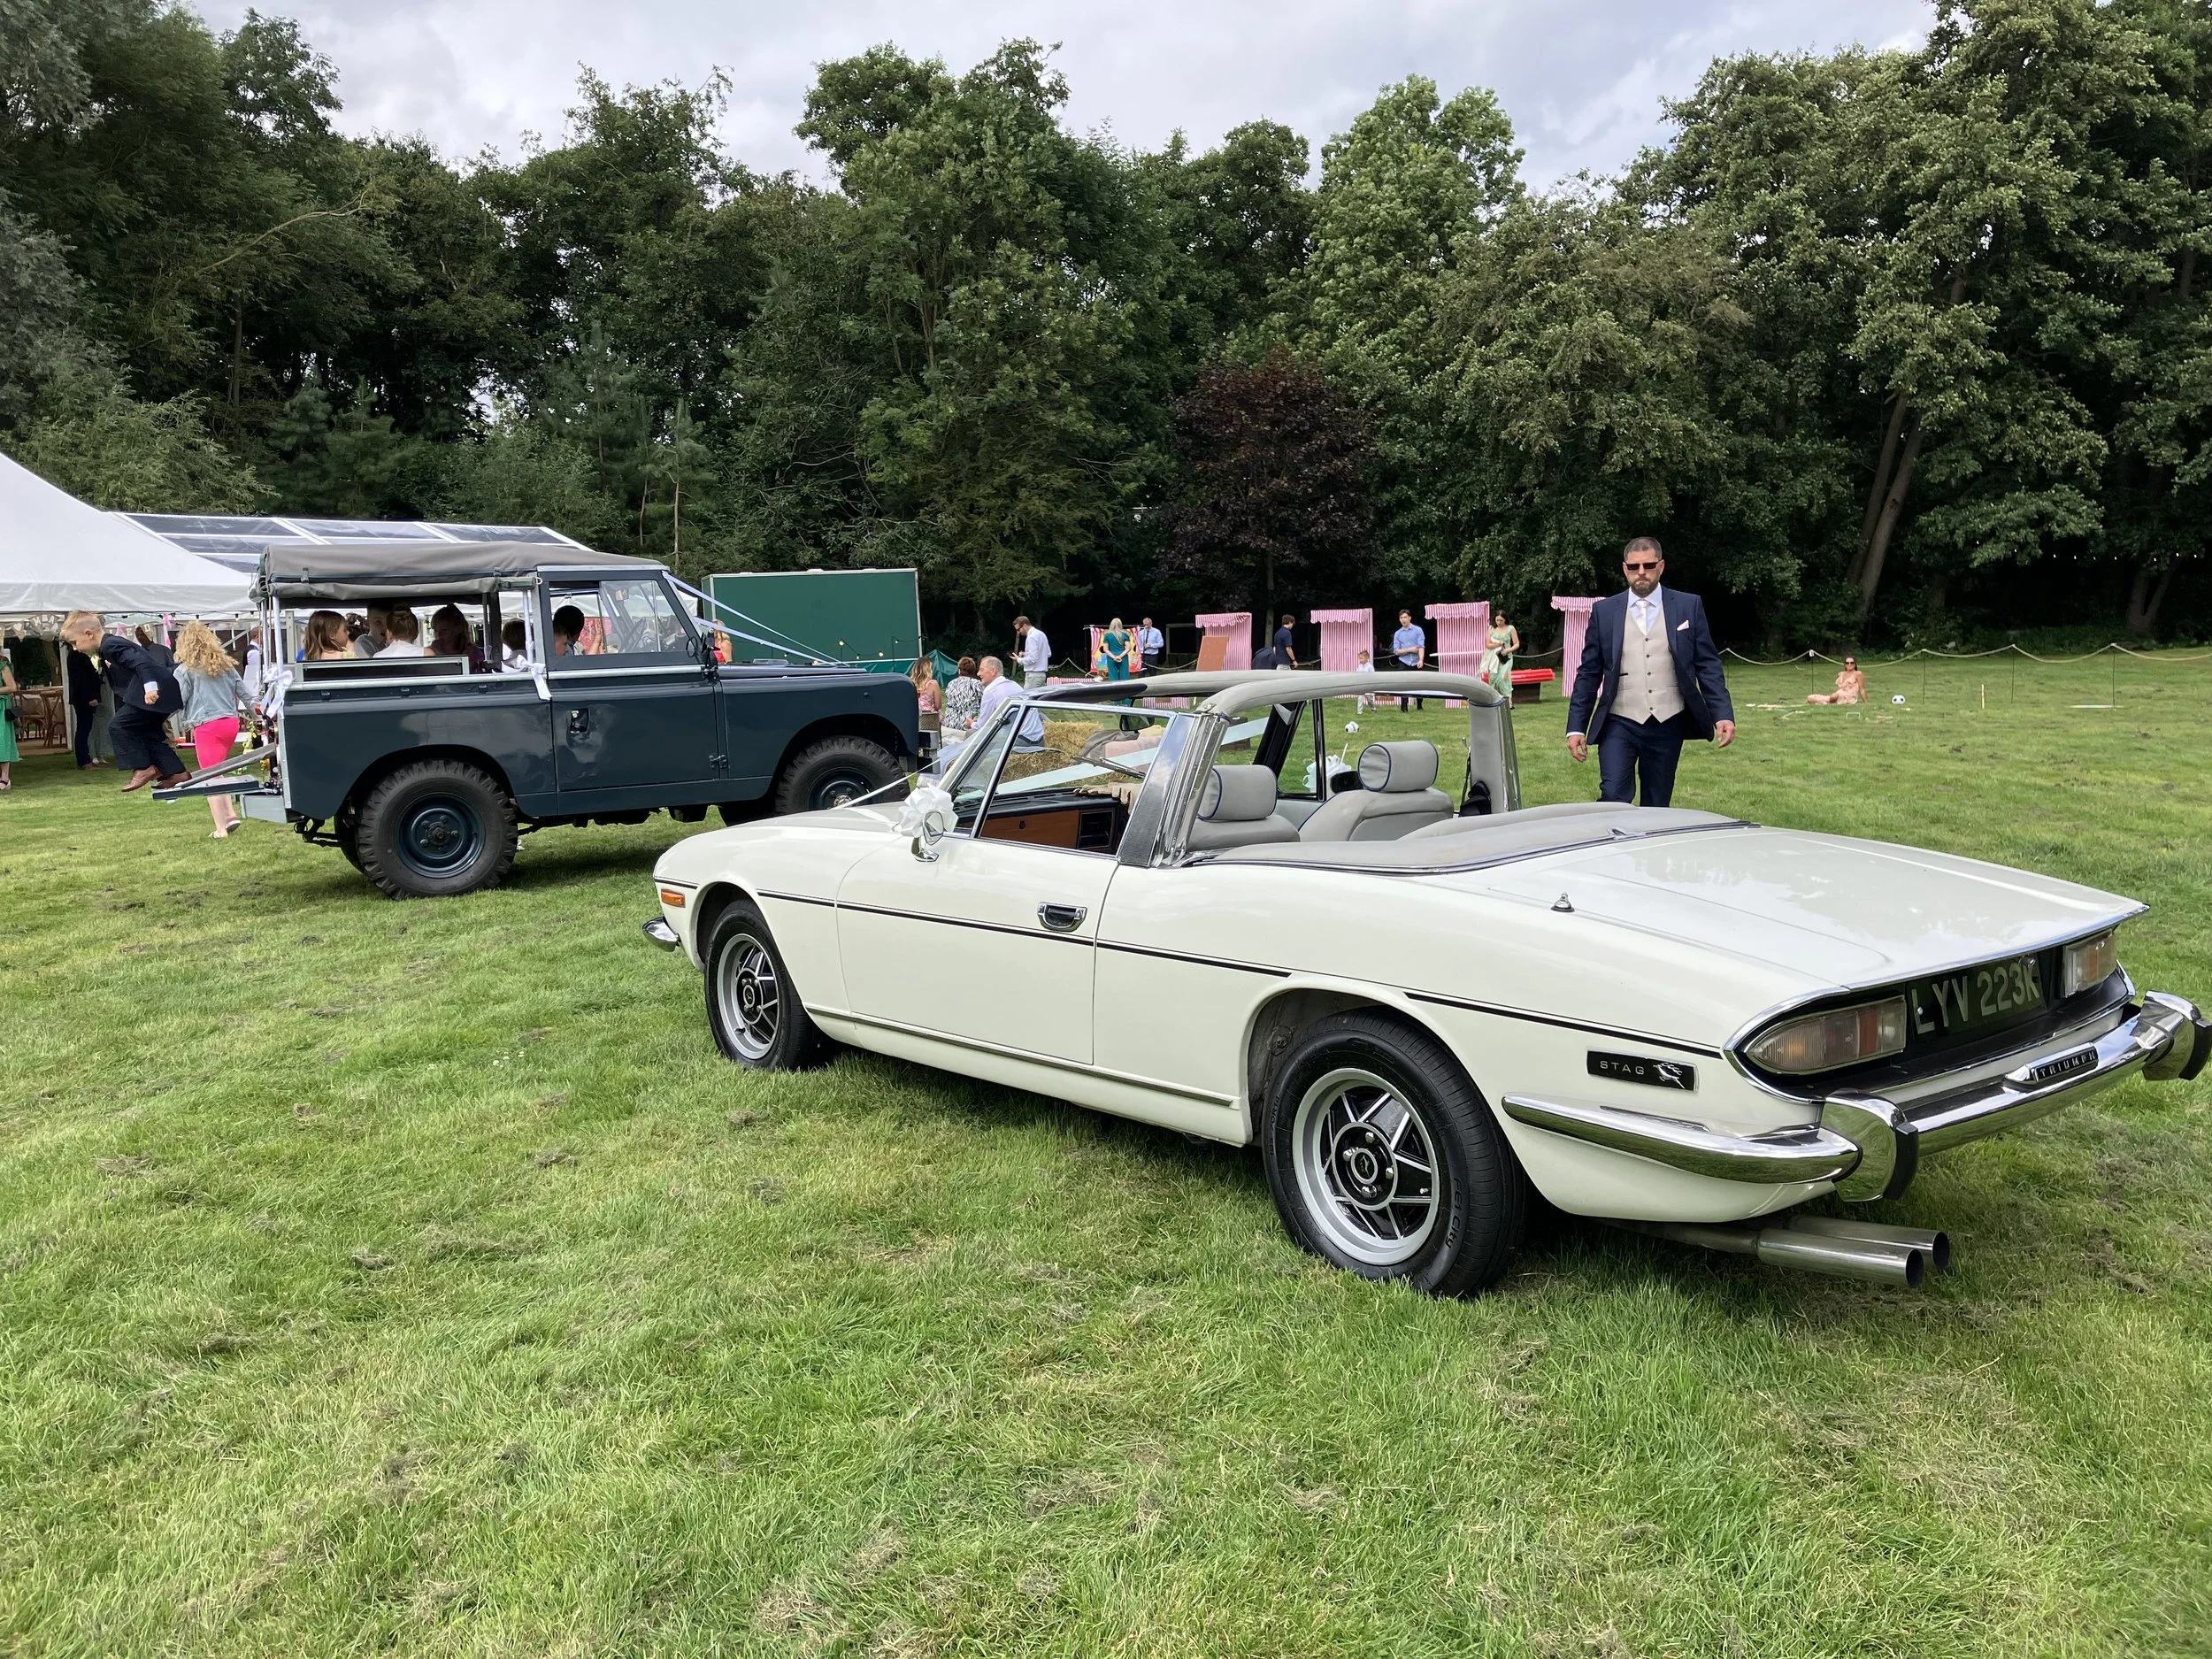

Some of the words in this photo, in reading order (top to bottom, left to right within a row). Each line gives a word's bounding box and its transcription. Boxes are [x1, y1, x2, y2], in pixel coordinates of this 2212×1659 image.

[1911, 976, 1968, 1034] LYV
[1977, 962, 2040, 1016] 223K
[1600, 1061, 1645, 1075] STAG
[2039, 1050, 2096, 1078] TRIUMPH
